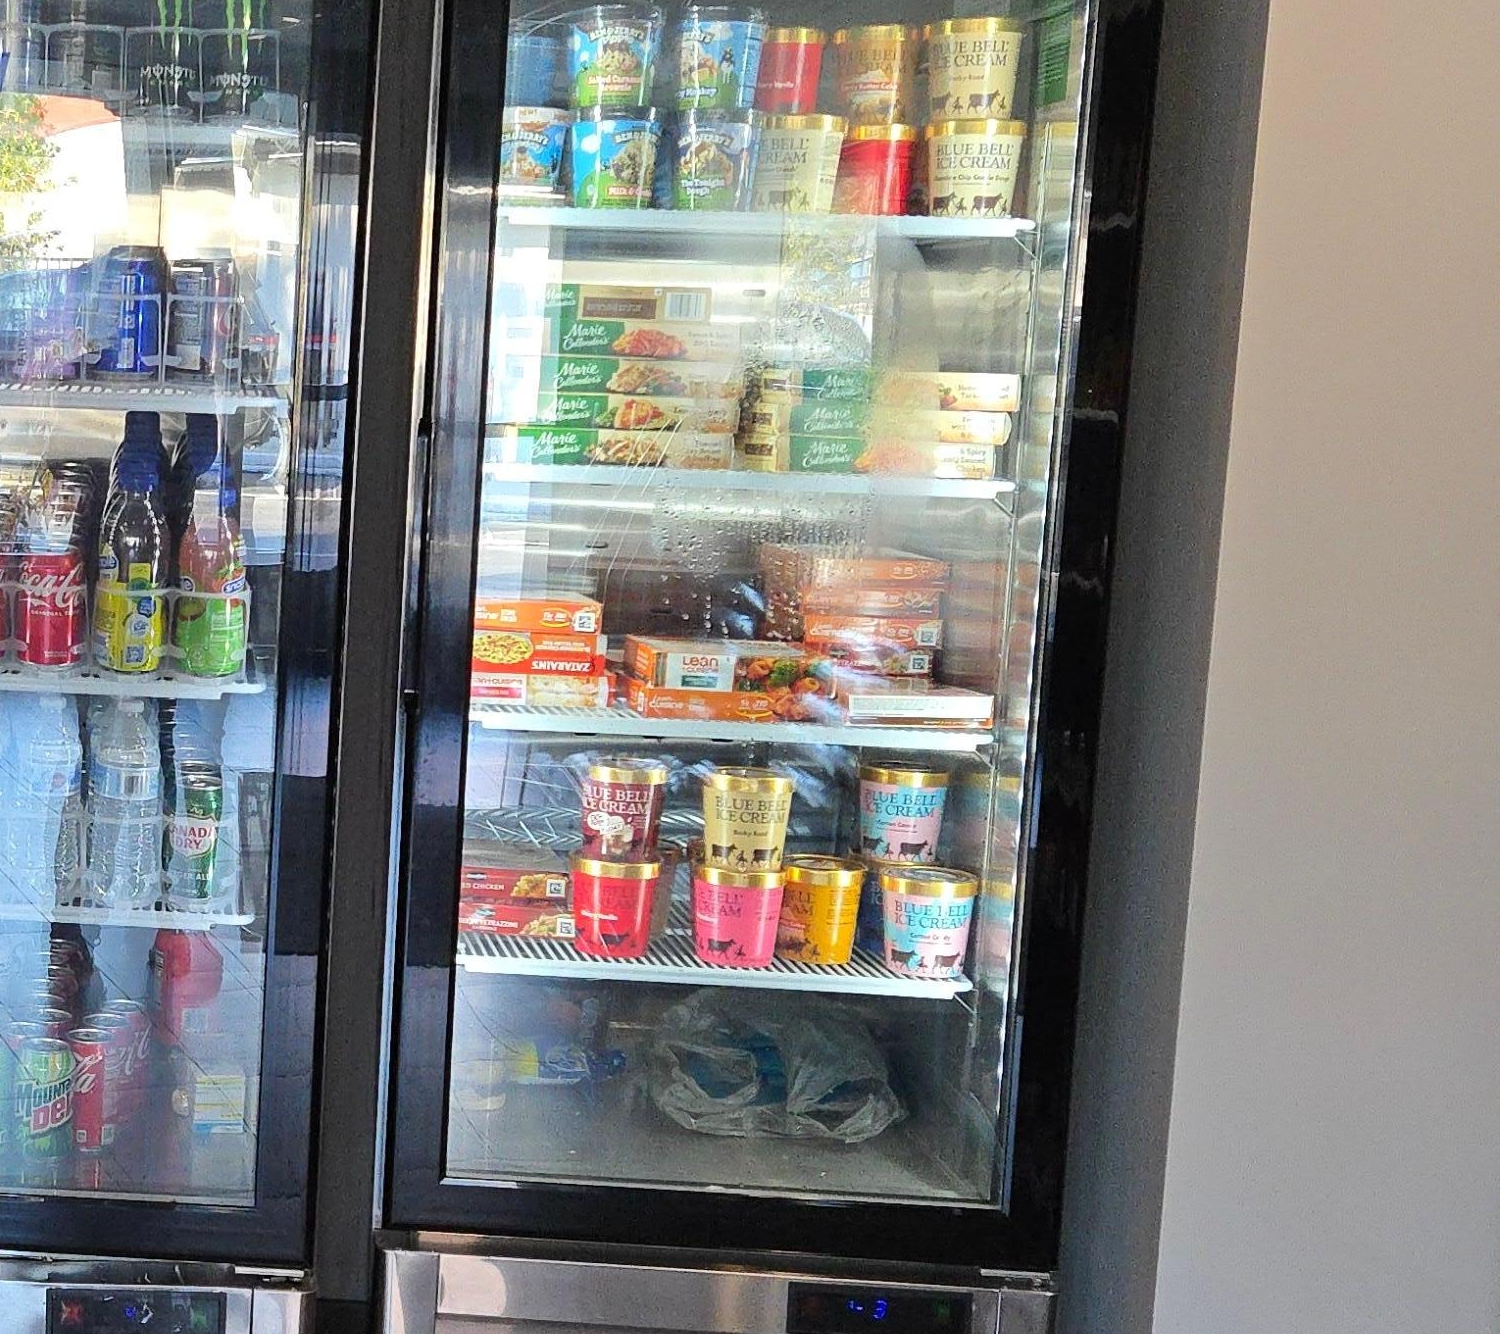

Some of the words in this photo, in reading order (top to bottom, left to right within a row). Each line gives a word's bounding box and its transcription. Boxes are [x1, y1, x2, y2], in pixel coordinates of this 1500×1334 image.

[954, 53, 1007, 68] CREAM
[937, 143, 974, 156] BLUE
[978, 143, 1014, 156] BELL
[959, 156, 1011, 170] CREAM
[563, 324, 607, 340] Marie
[555, 362, 600, 378] Marie
[533, 431, 578, 447] Marie
[804, 442, 849, 456] Marie
[682, 656, 719, 666] Lean
[715, 795, 754, 811] BLUE
[716, 807, 738, 823] ICE
[175, 836, 203, 850] DRY
[472, 883, 505, 891] CHICKEN
[894, 898, 933, 916] BLUE
[894, 912, 915, 927] ICE
